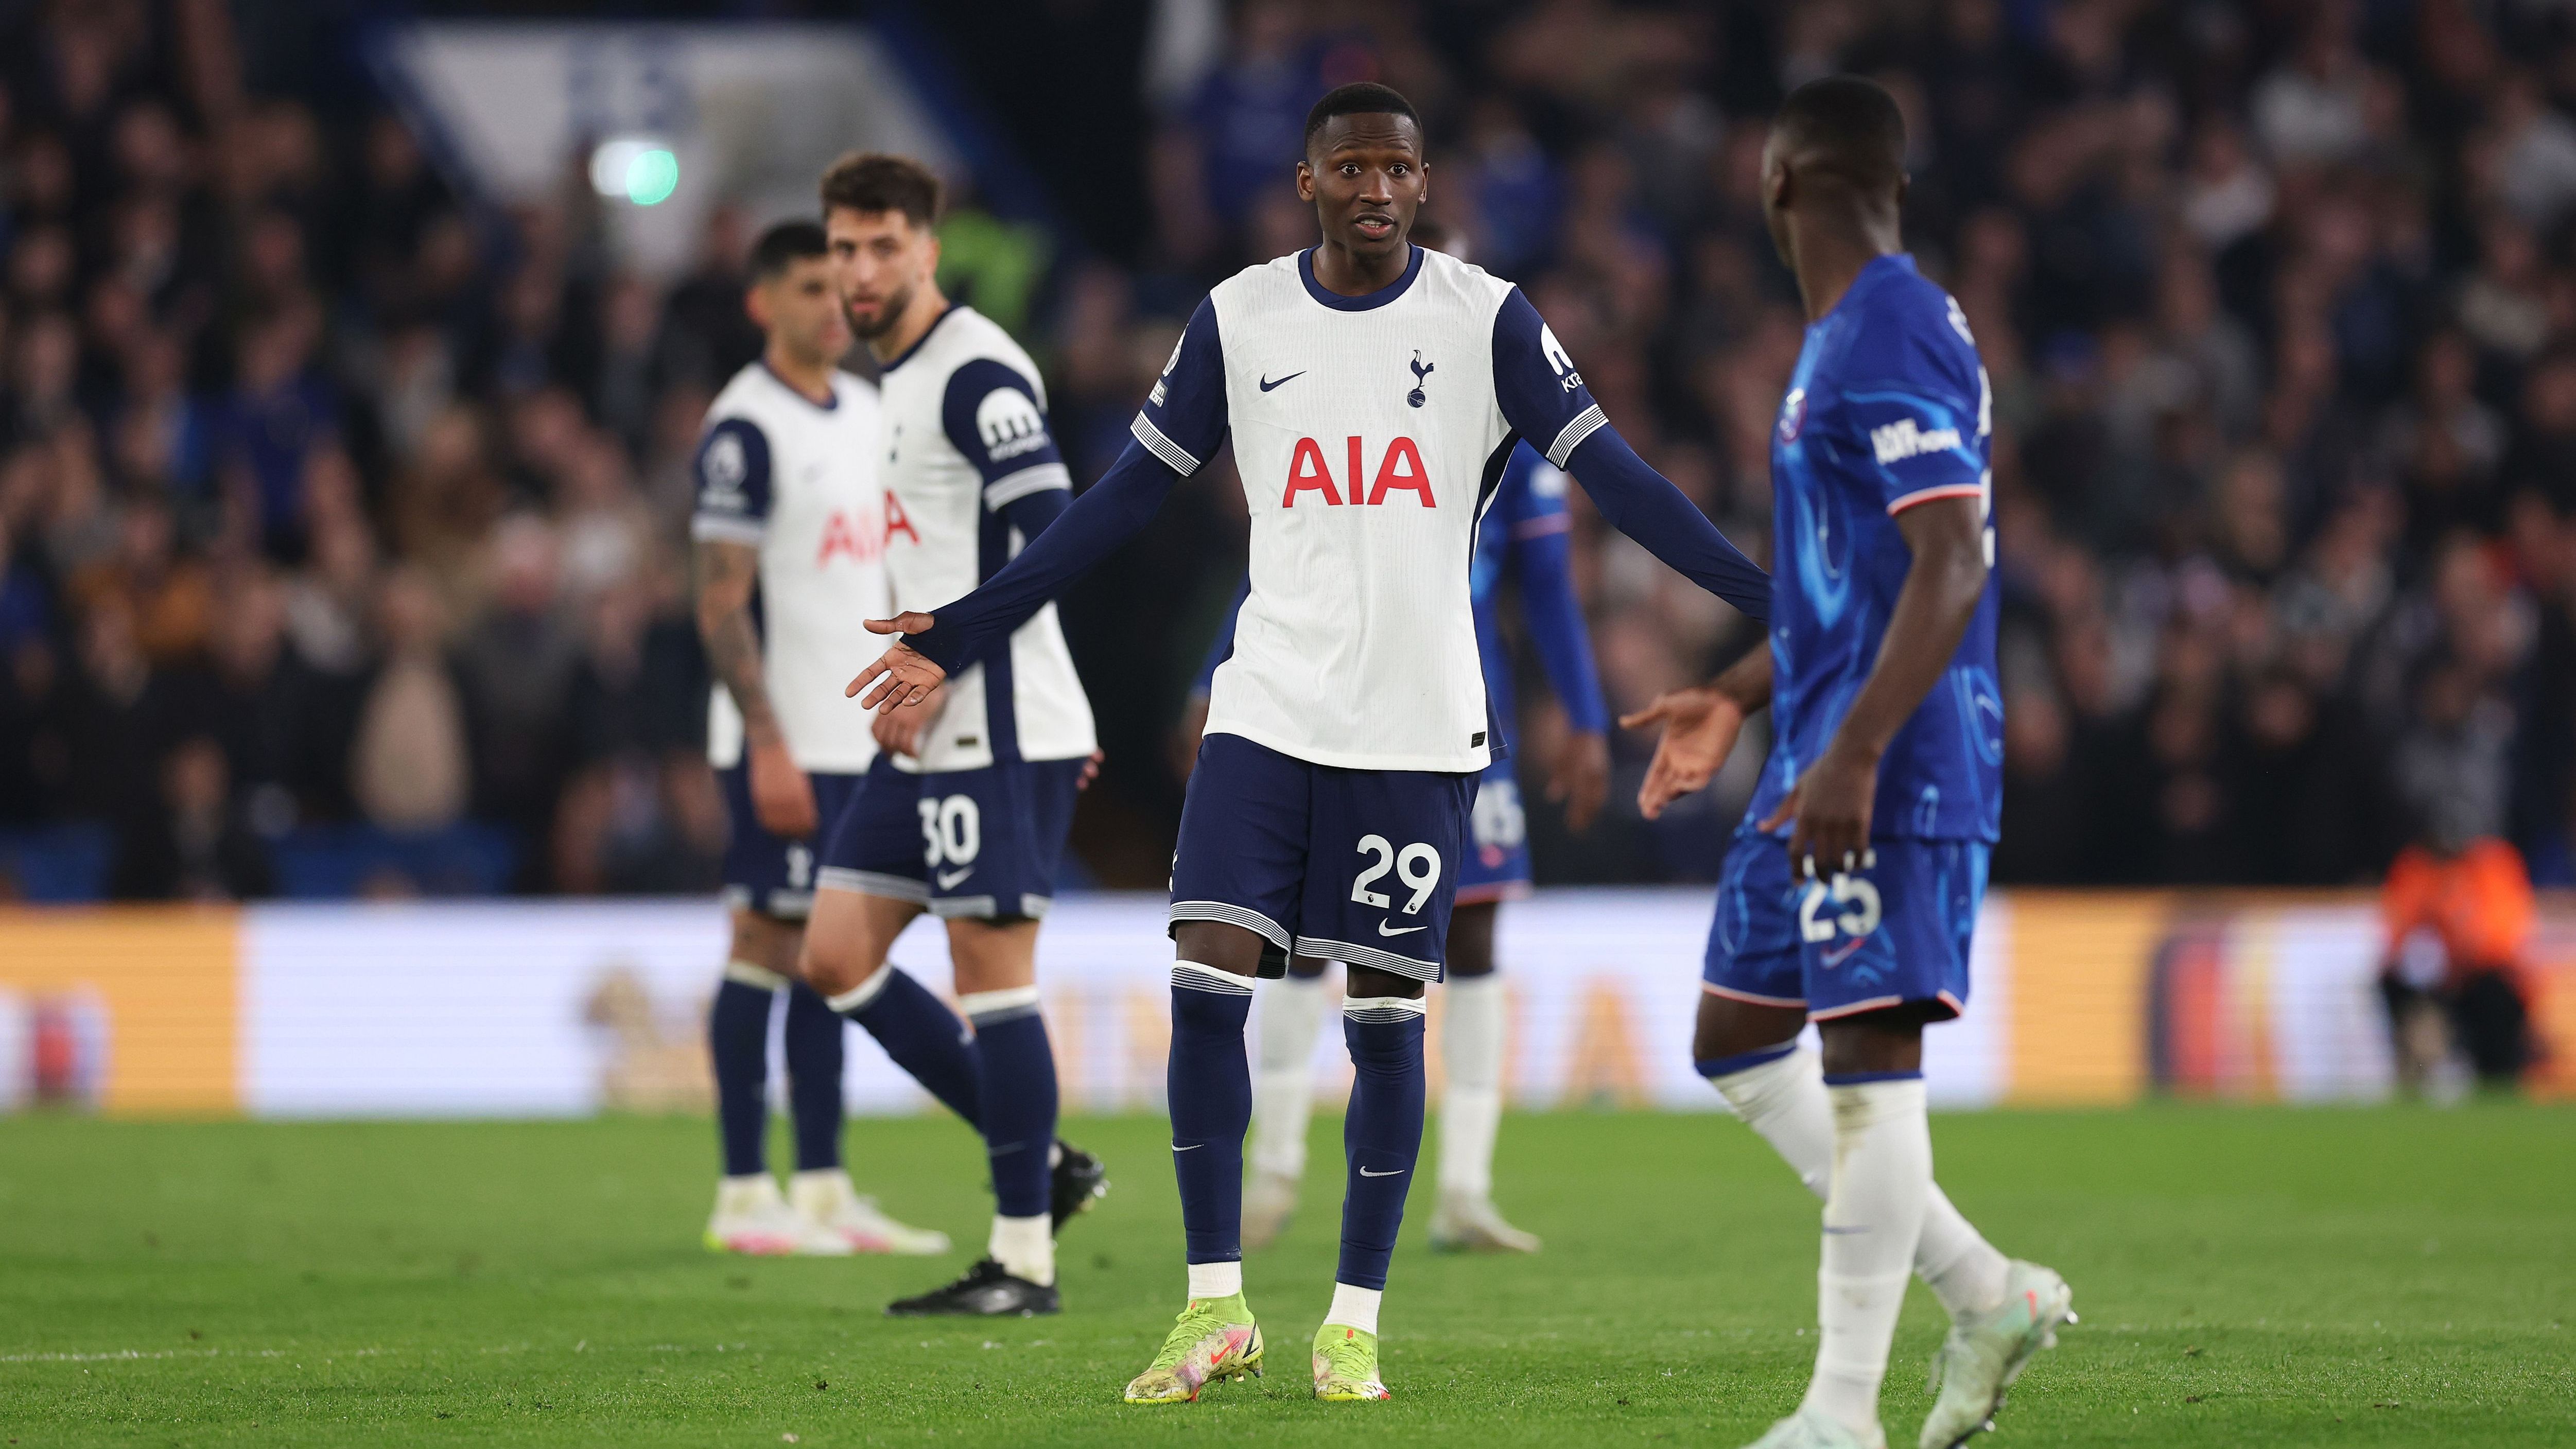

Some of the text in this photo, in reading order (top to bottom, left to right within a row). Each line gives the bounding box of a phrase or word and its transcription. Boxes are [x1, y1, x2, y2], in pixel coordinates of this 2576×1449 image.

[1282, 435, 1436, 508] AIA
[917, 794, 981, 868] 30
[1351, 834, 1441, 915] 29
